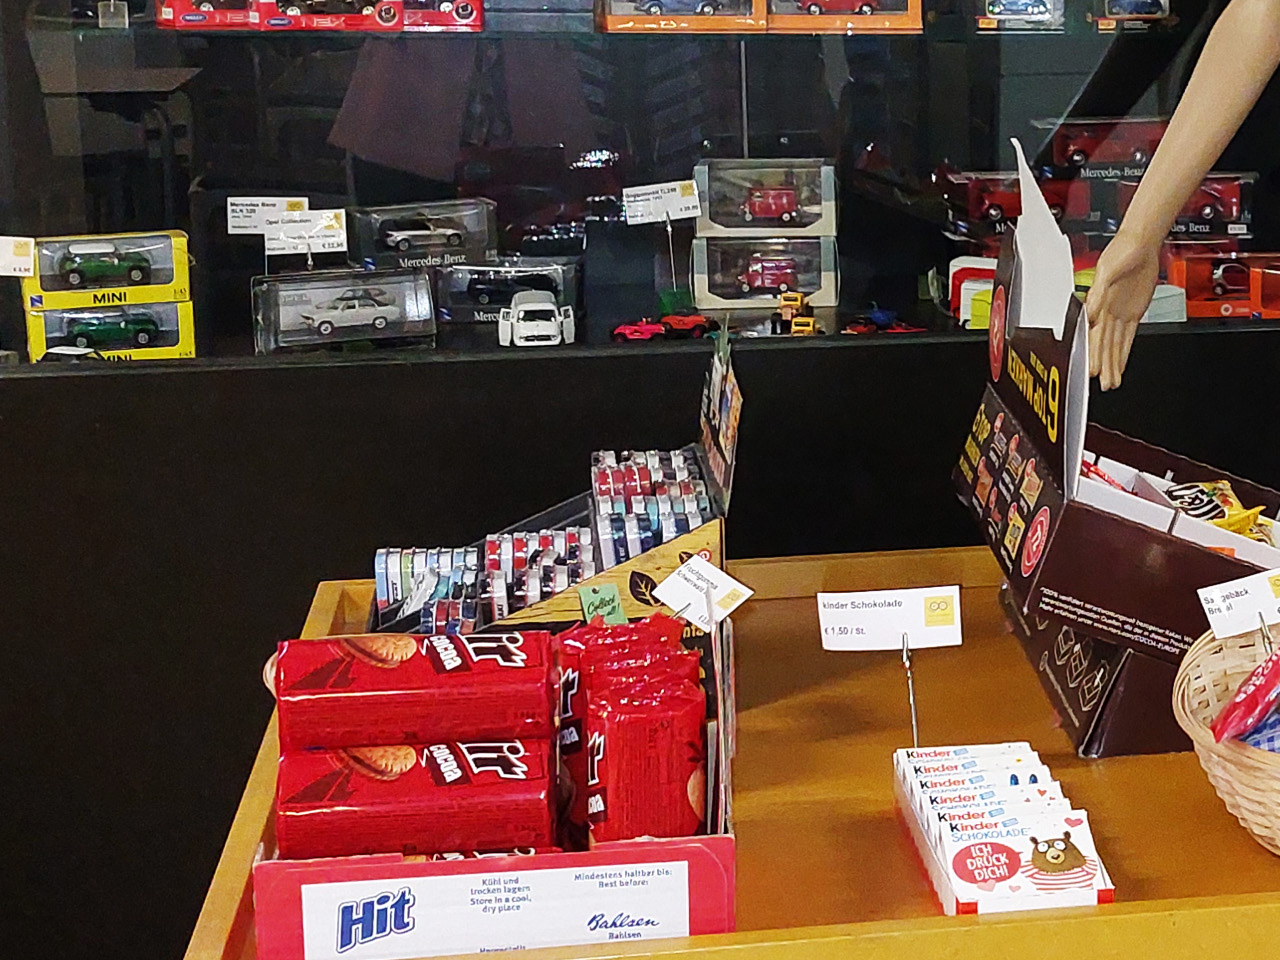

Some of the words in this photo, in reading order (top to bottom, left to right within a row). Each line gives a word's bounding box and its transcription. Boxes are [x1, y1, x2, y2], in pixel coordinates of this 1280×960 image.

[93, 291, 127, 304] MINI
[1047, 366, 1060, 443] 6
[823, 601, 848, 609] kinder
[850, 600, 903, 609] Schokolade
[831, 627, 848, 636] 1,50
[430, 635, 462, 670] cocoa
[430, 744, 462, 783] cocoa
[951, 828, 1029, 842] SCHOKOLADE
[970, 844, 992, 858] ICH
[574, 871, 622, 881] Mindestens
[624, 870, 655, 878] haltbar
[974, 867, 1009, 881] DICH!
[482, 877, 501, 886] Kühl
[598, 880, 617, 888] Best
[619, 879, 648, 887] before:
[470, 887, 502, 895] trocken
[504, 886, 531, 894] lagern
[470, 897, 492, 906] Store
[511, 894, 532, 903] cool,
[482, 906, 496, 914] dry
[498, 904, 520, 913] place
[337, 887, 415, 952] Hit
[587, 912, 660, 931] Bahlsen
[608, 932, 642, 940] Bahlsen
